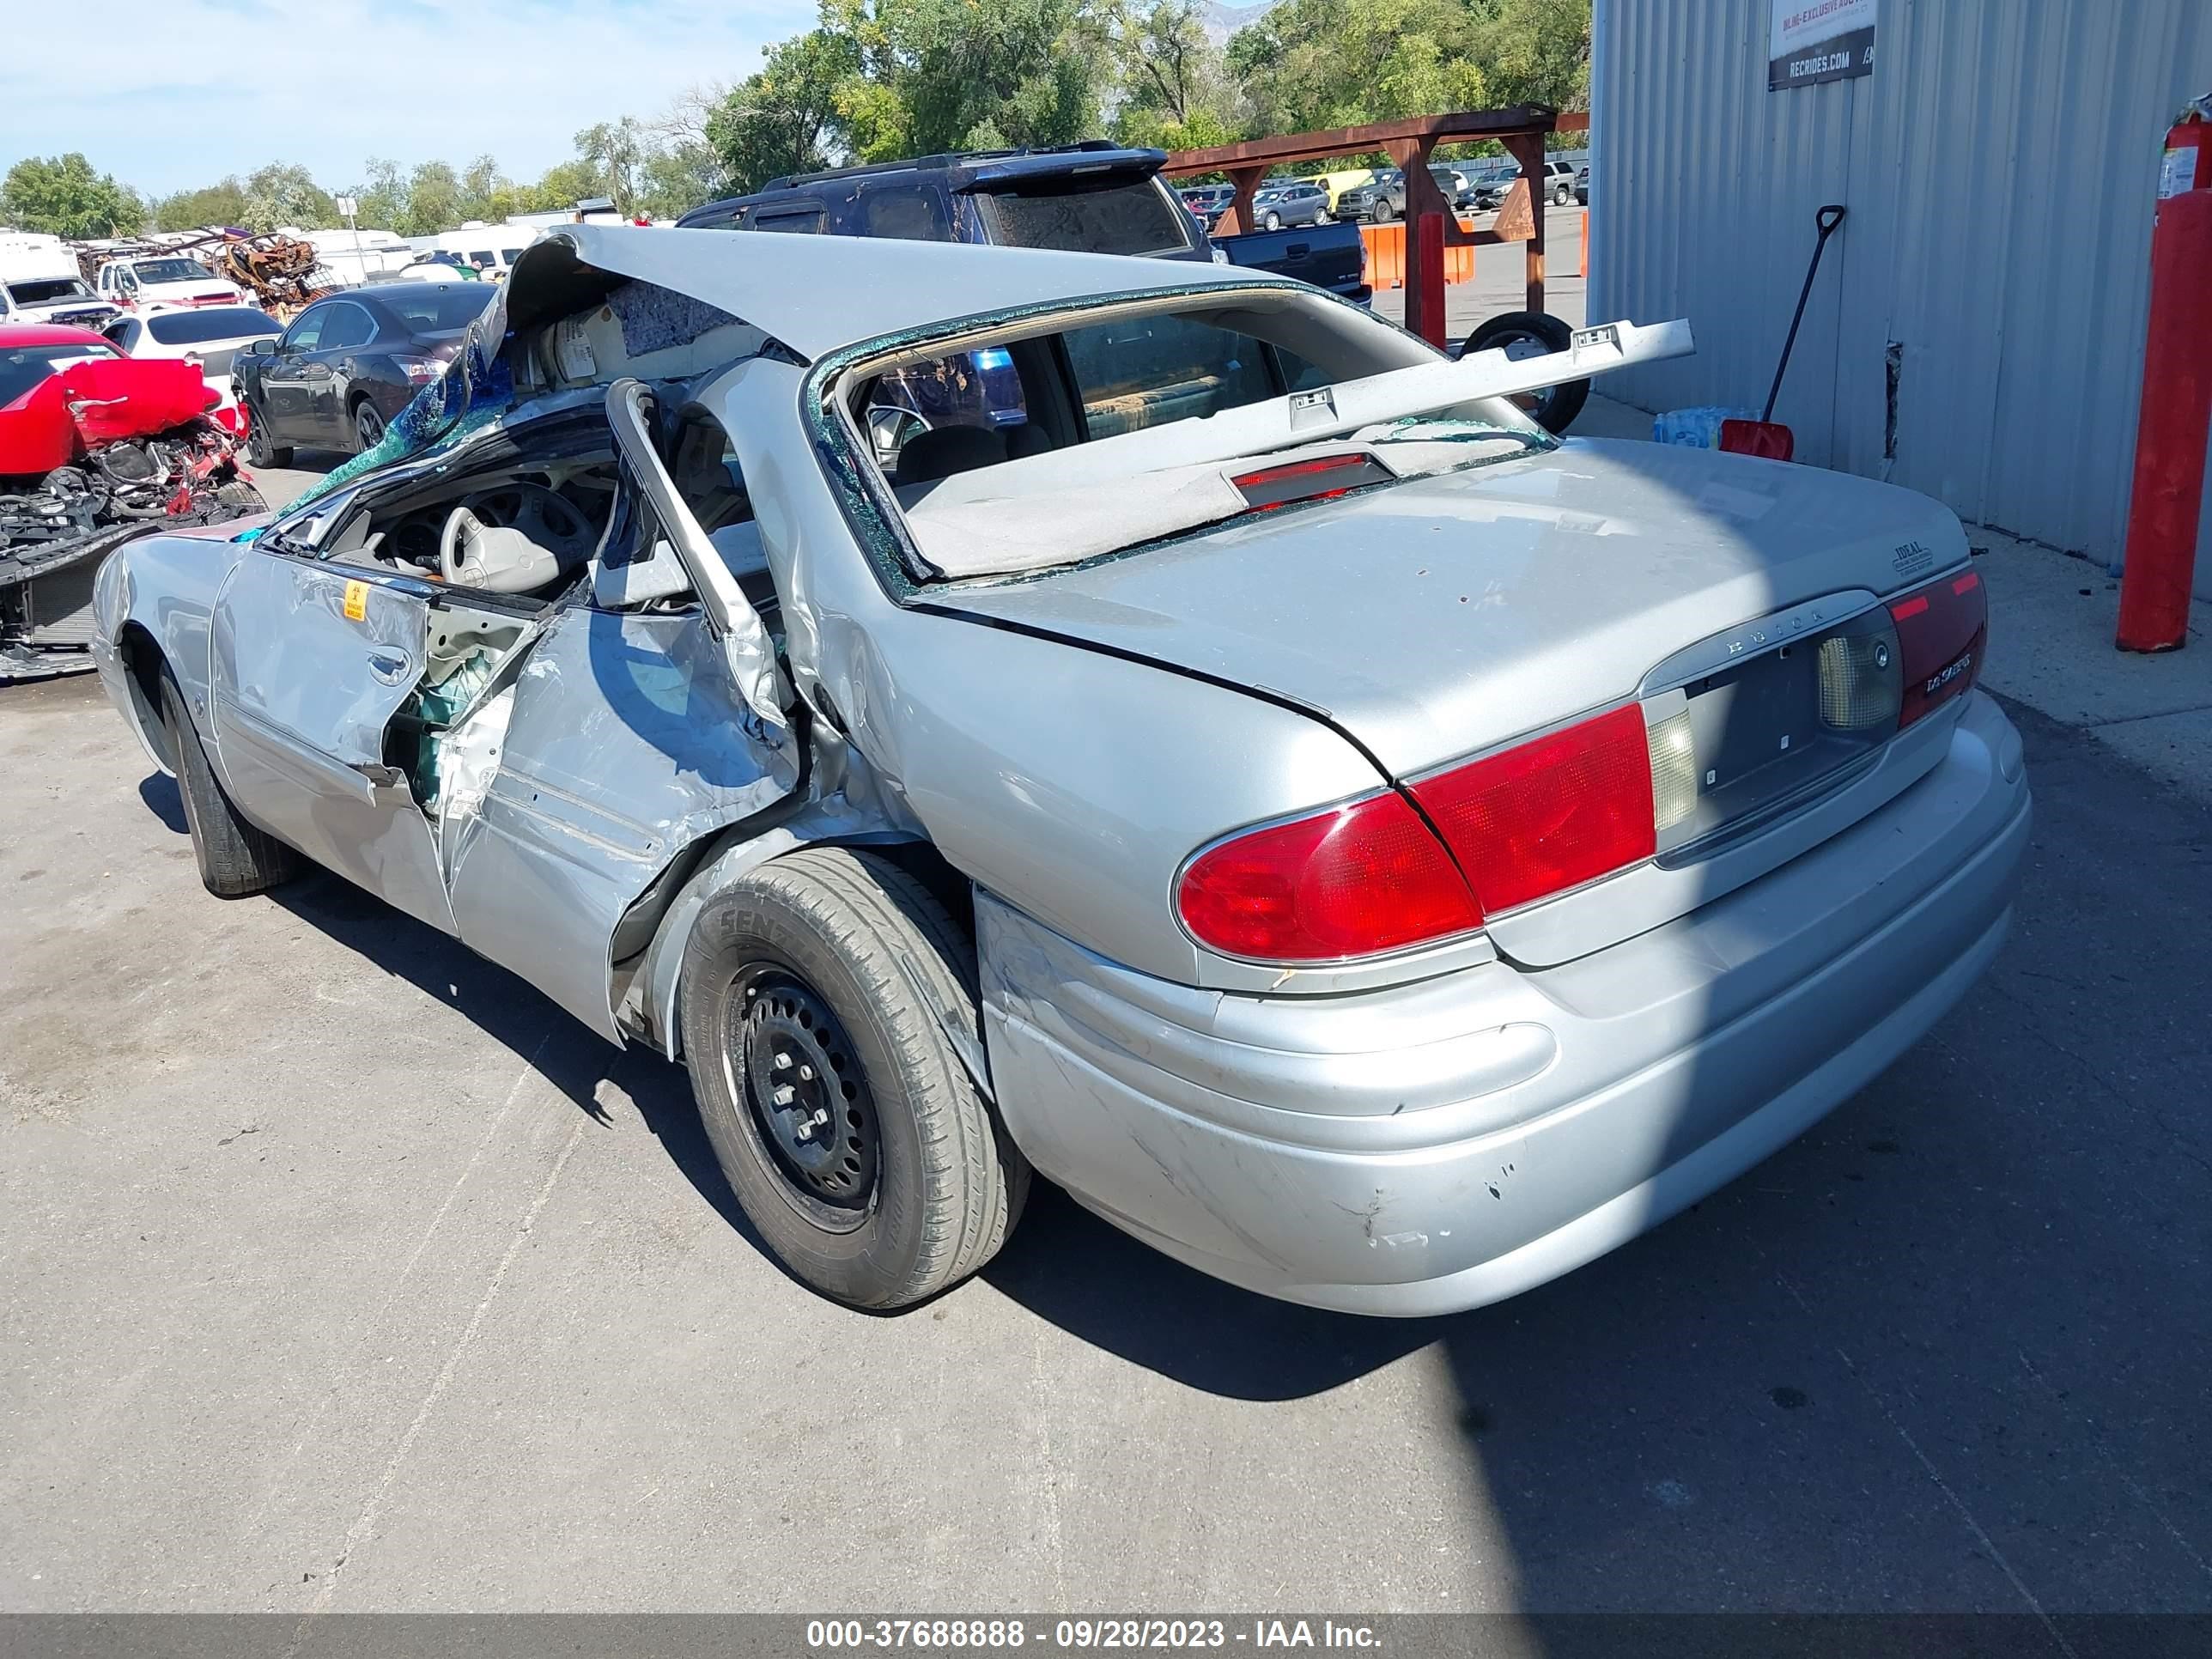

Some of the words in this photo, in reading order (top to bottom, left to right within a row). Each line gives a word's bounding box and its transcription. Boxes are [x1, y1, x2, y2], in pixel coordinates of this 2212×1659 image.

[1790, 51, 1850, 78] RECRIDES.COM
[1895, 541, 1923, 560] IDEAL
[1726, 611, 1823, 654] BUICK
